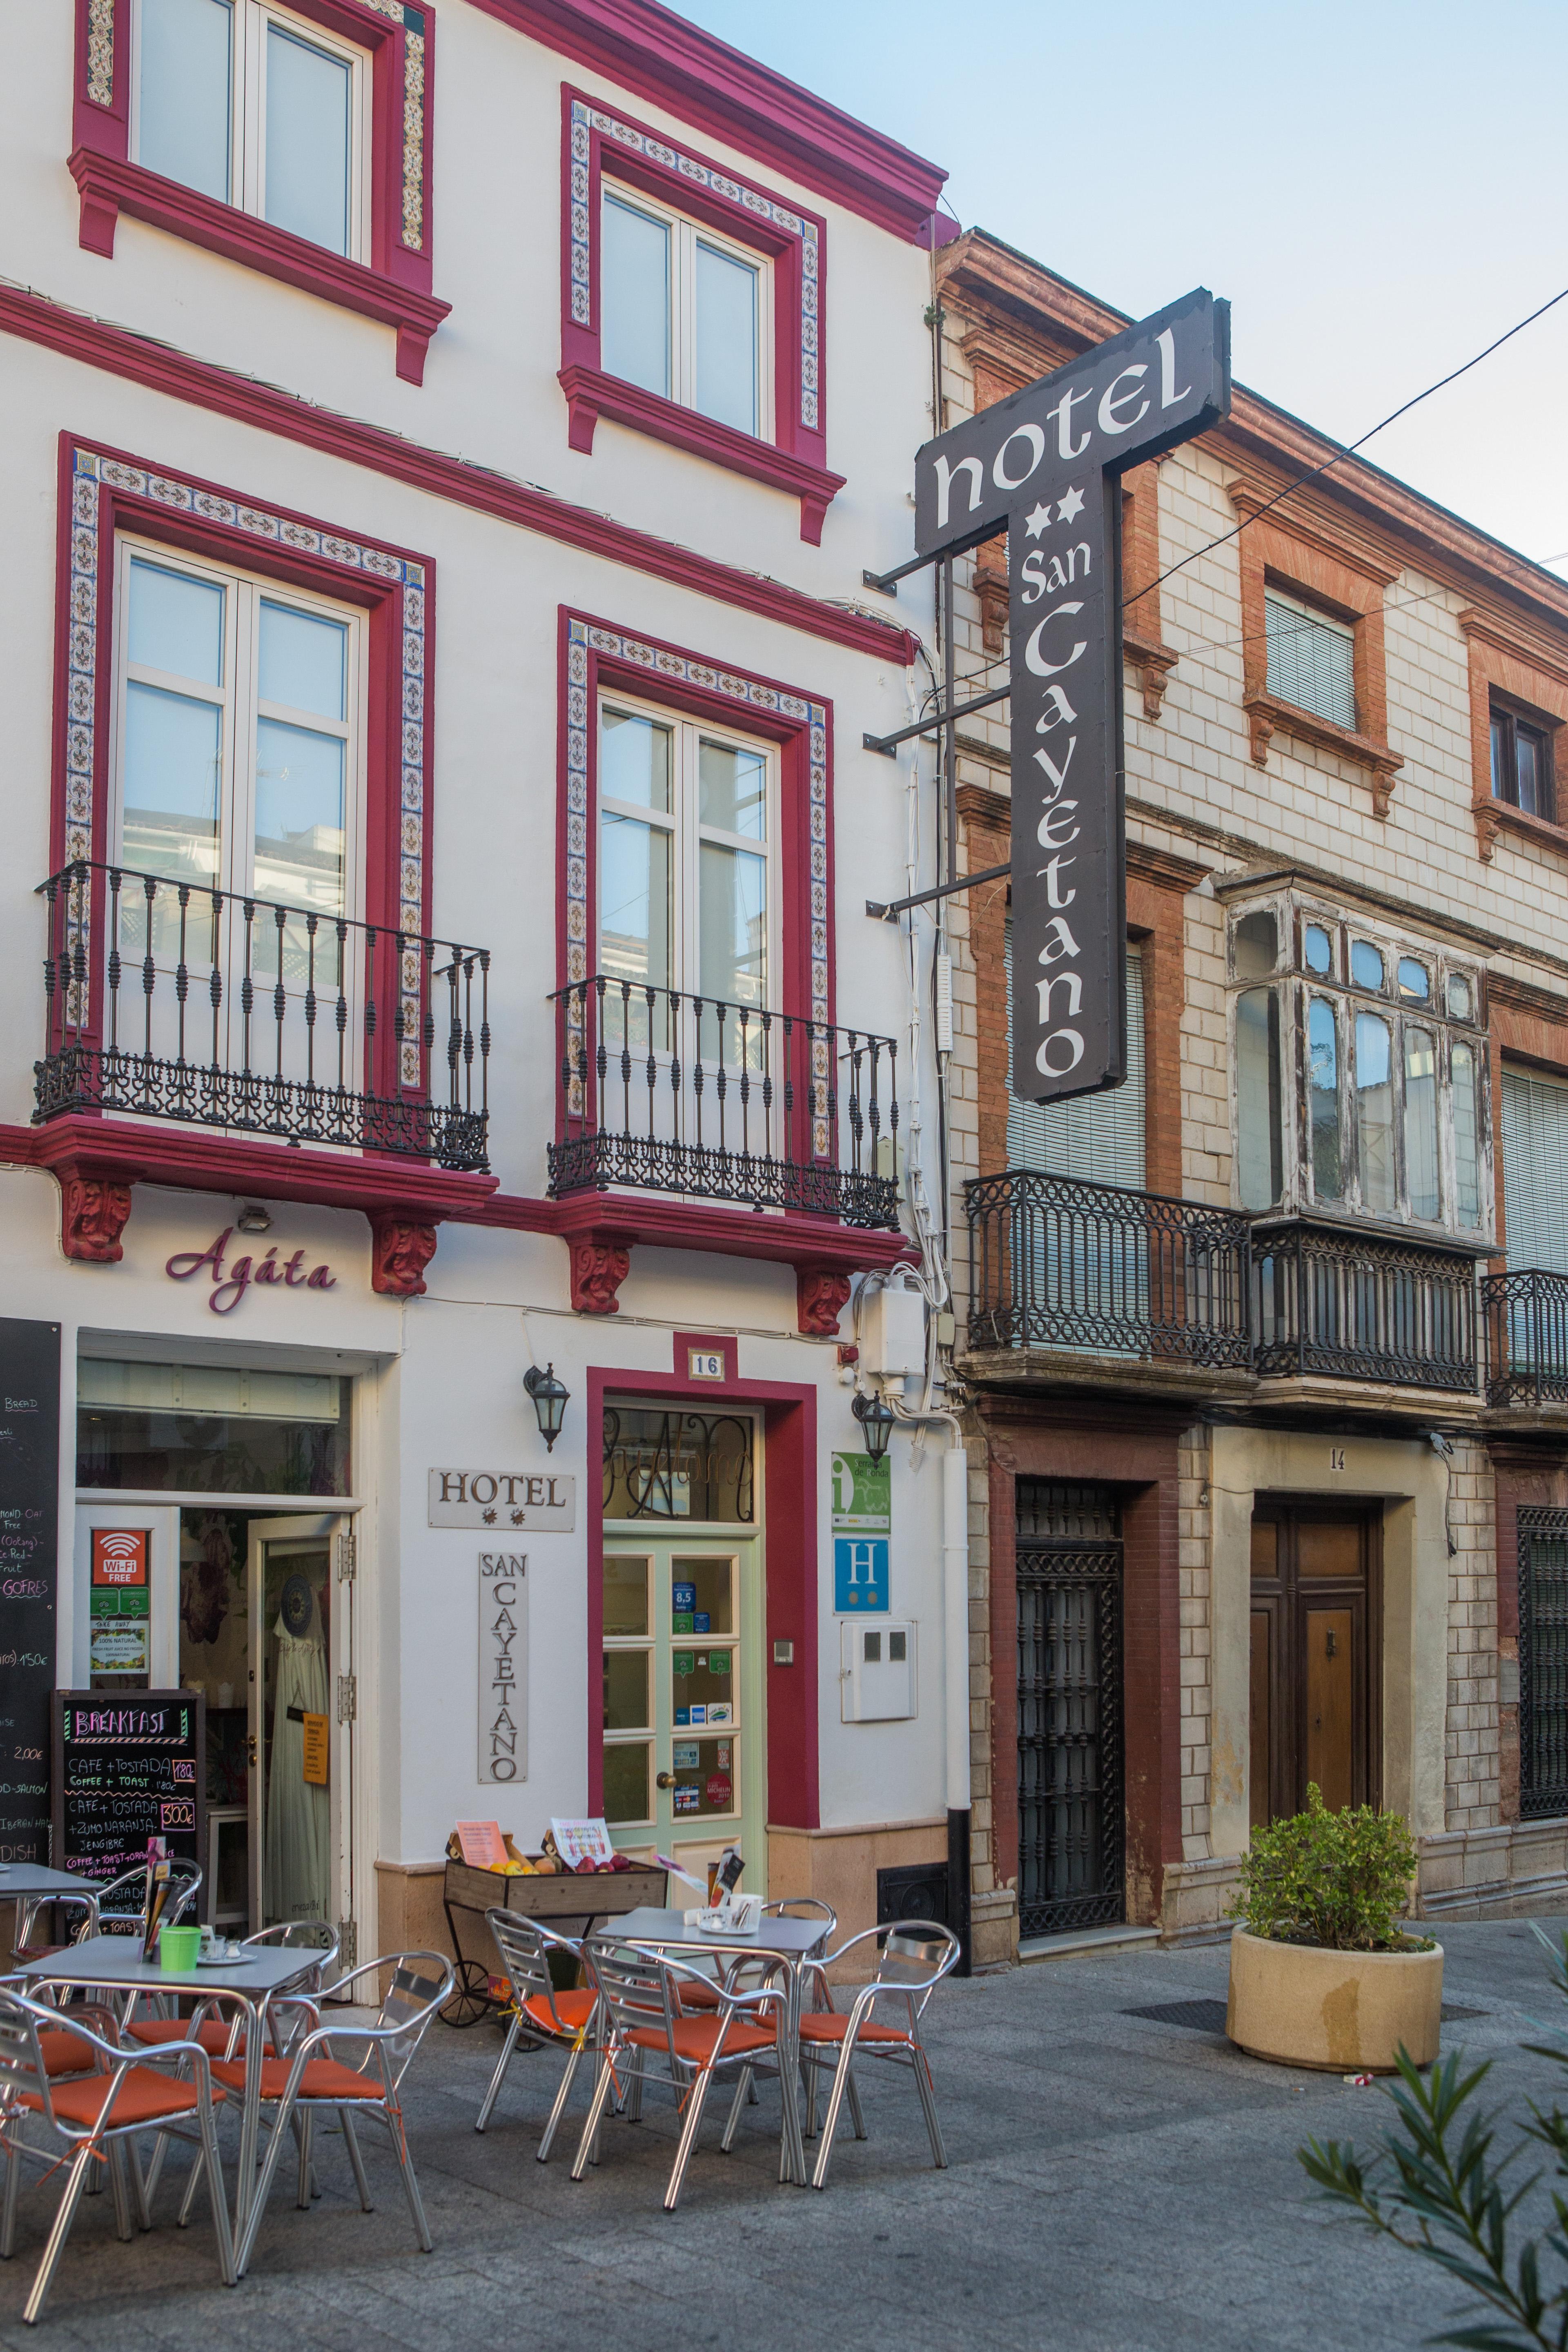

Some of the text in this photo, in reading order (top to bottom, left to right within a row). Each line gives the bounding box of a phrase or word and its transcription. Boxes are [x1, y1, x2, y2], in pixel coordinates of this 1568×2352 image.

[1020, 541, 1091, 604] San
[1025, 601, 1087, 1078] Cayetano
[165, 1226, 337, 1313] Agáta
[696, 1356, 718, 1374] 16
[4, 1397, 38, 1409] BREAD
[1332, 1448, 1344, 1470] 14
[867, 1468, 889, 1477] Ronda
[439, 1472, 566, 1508] HOTEL
[4, 1520, 21, 1529] Free
[105, 1561, 135, 1571] Wi-Fi
[481, 1554, 527, 1577] SAN
[847, 1543, 878, 1585] H
[109, 1574, 131, 1582] FREE
[676, 1592, 691, 1603] 8,5
[490, 1581, 518, 1781] CAYETANO
[76, 1708, 169, 1737] BREAKFAST
[69, 1758, 102, 1773] CAFE
[70, 1775, 102, 1787] COFFEE
[119, 1777, 149, 1788] TOAST
[69, 1799, 99, 1814] CAFE
[110, 1799, 158, 1815] TOSTADA
[0, 1843, 36, 1862] DISH
[80, 1838, 124, 1851] JENGIBRE
[67, 1858, 93, 1869] COFFEE
[88, 1867, 117, 1876] GINGER
